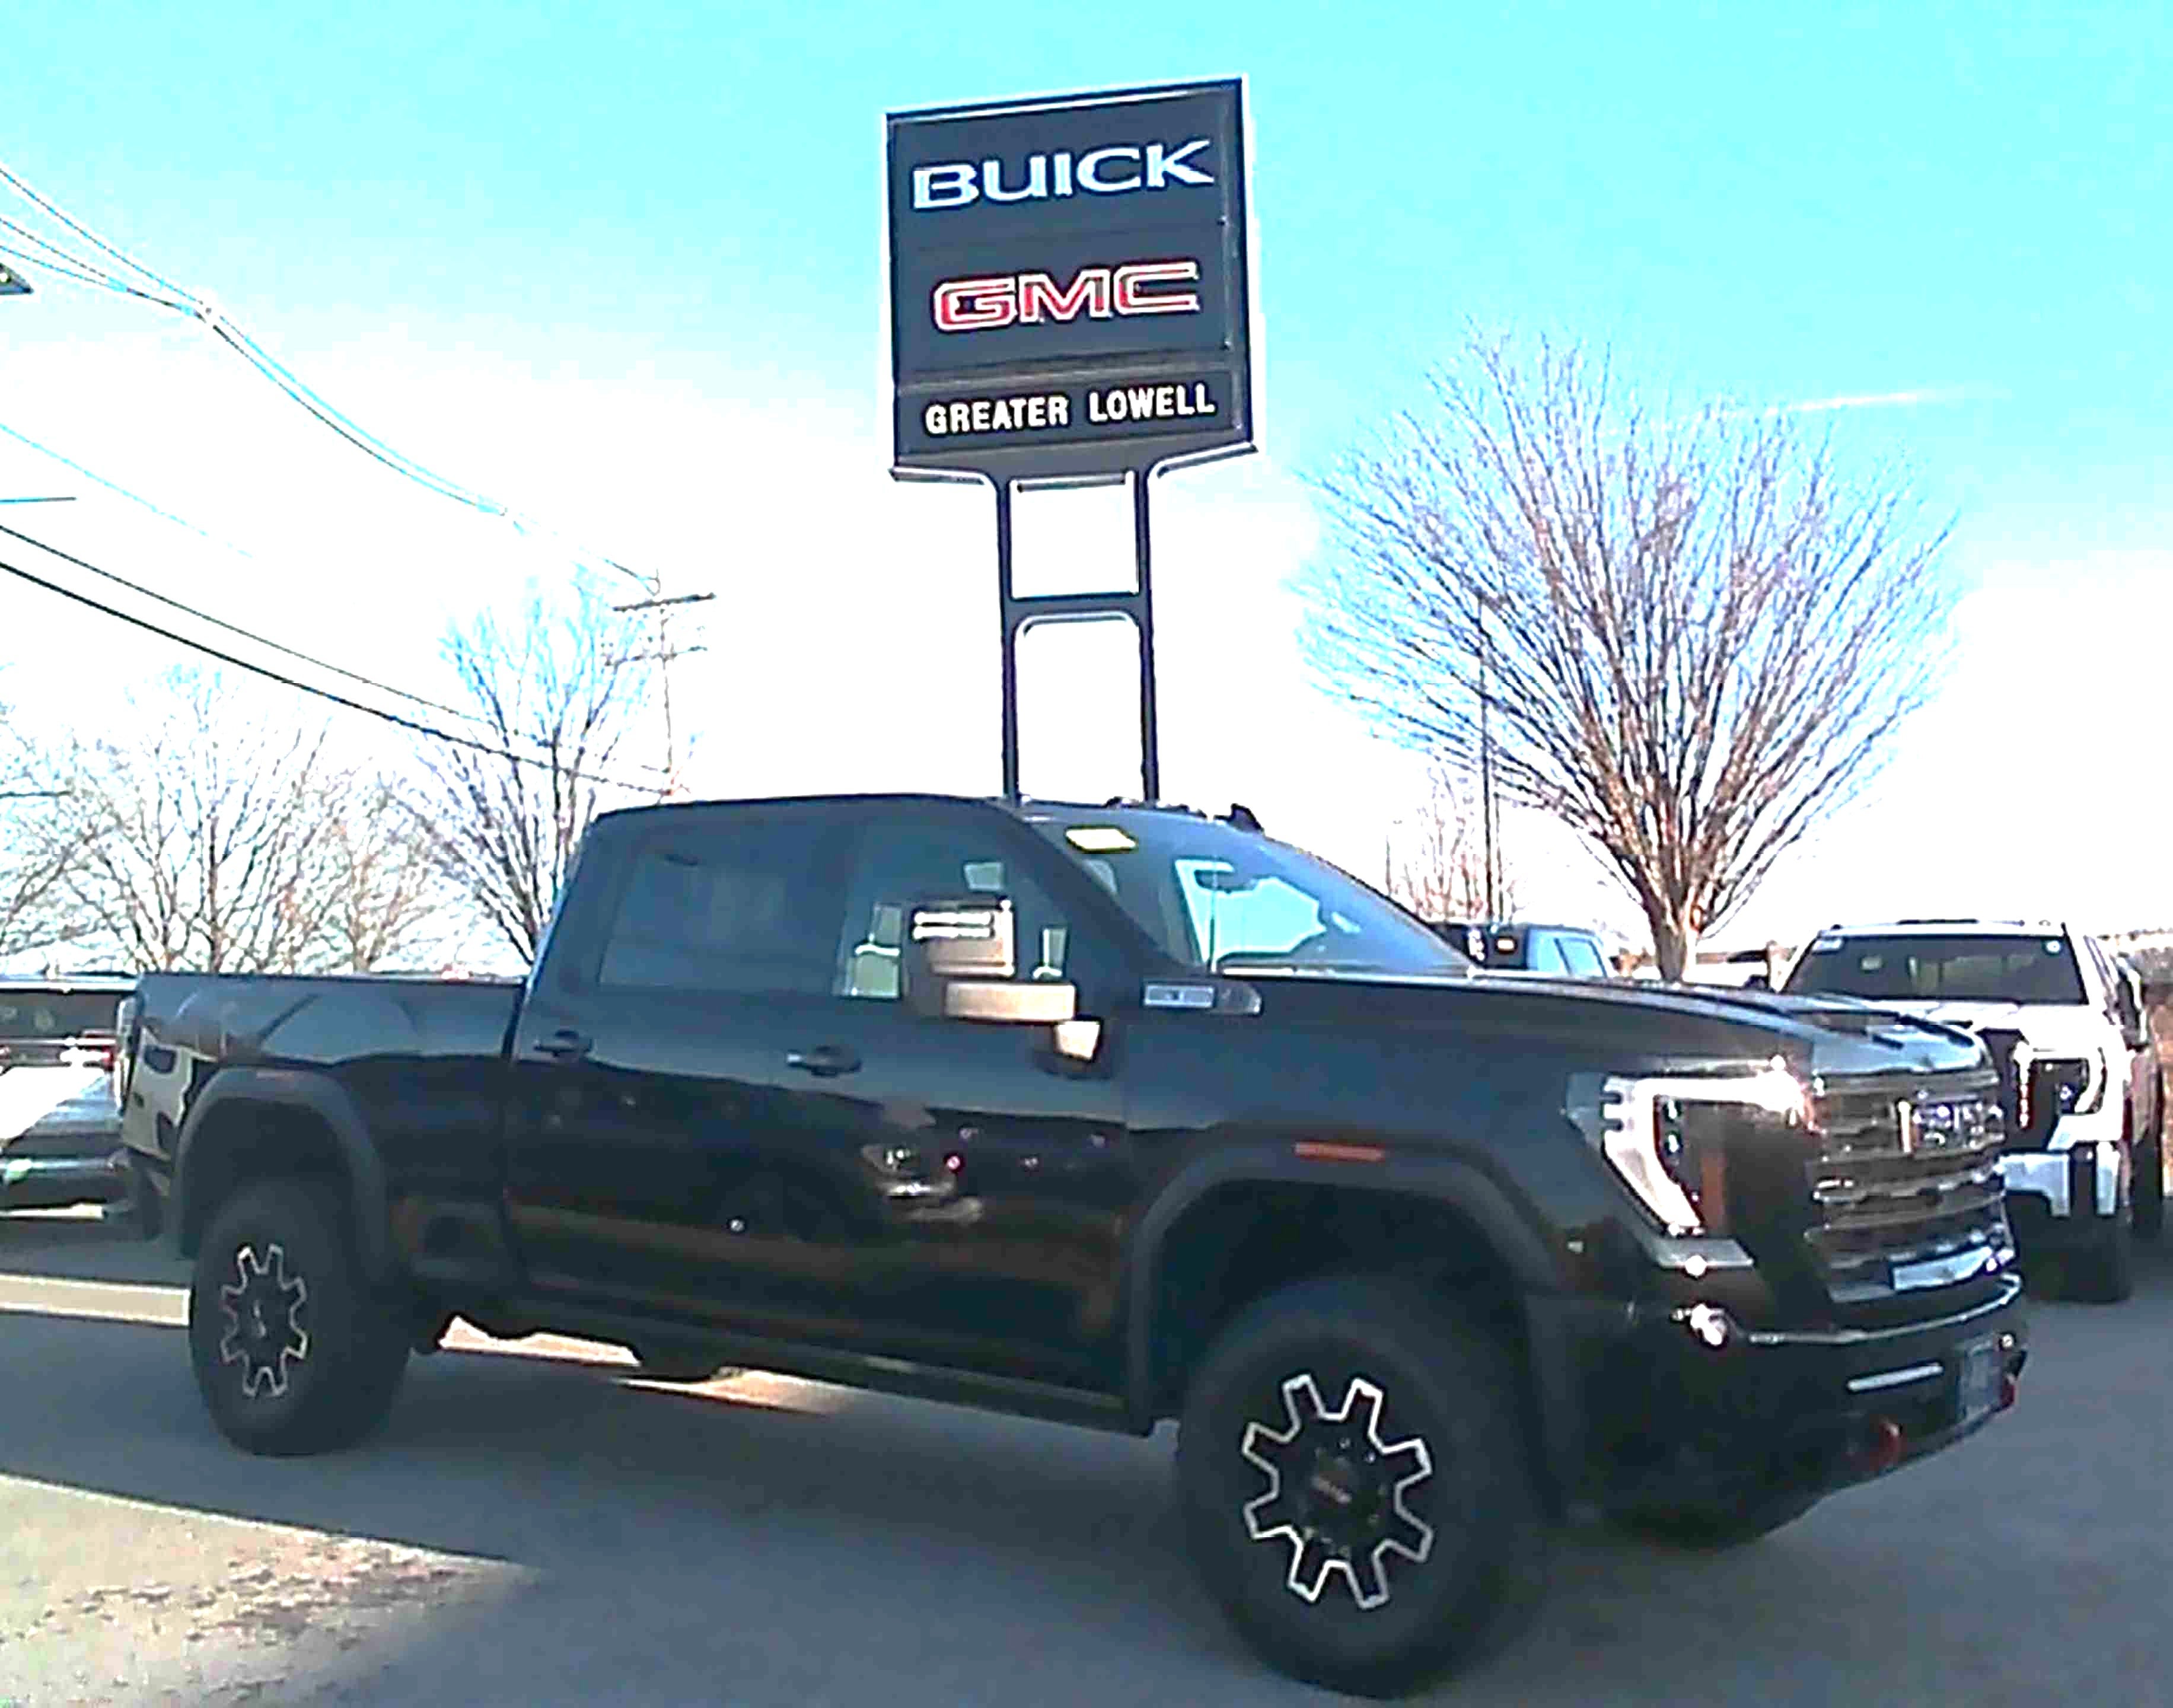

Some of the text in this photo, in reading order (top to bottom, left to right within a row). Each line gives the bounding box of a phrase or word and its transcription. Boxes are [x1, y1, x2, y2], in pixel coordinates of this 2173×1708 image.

[913, 141, 1213, 208] BUICK
[934, 262, 1199, 330] GMC
[926, 384, 1215, 434] GREATER LOWELL
